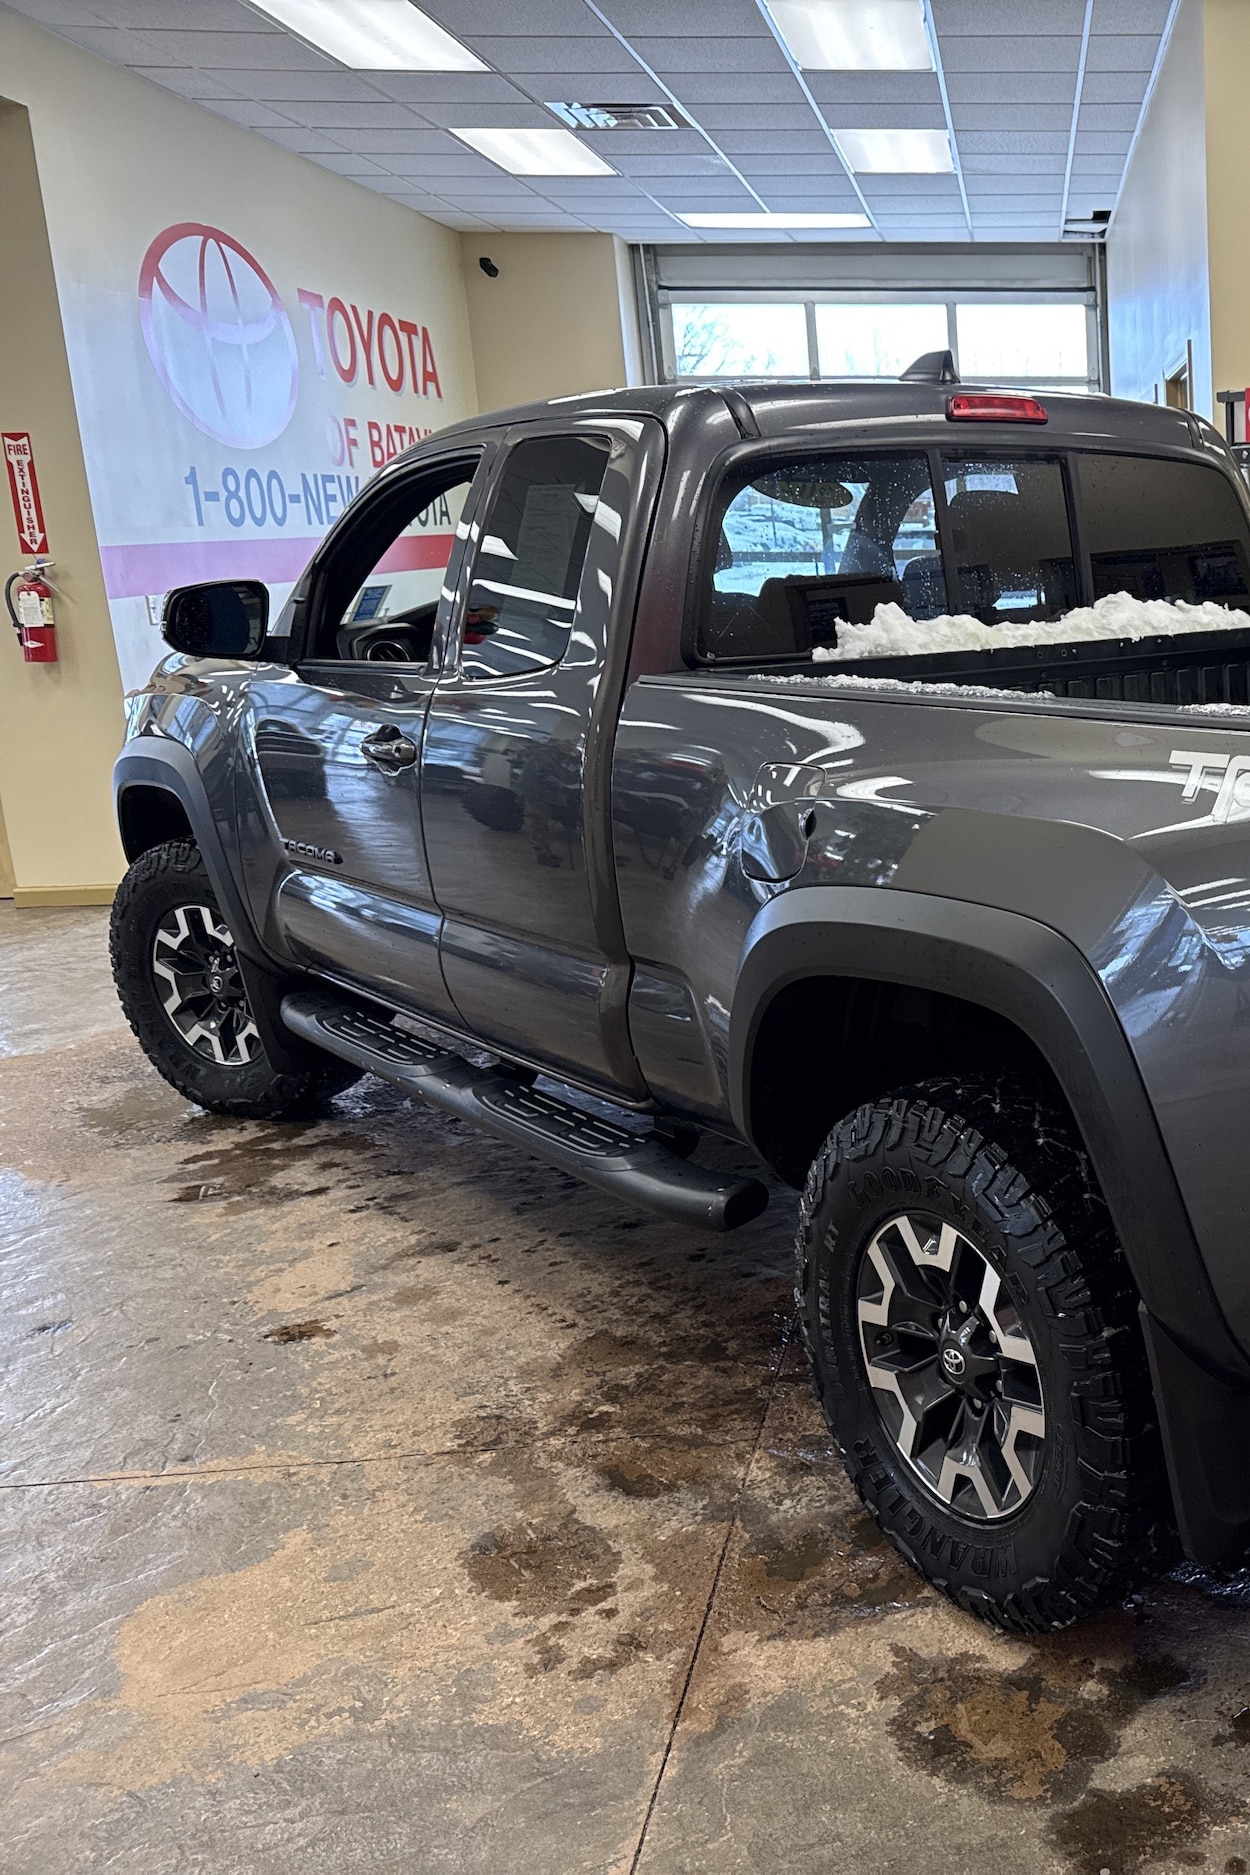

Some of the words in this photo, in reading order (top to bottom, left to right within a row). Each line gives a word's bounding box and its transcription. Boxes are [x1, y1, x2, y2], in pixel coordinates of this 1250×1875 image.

[296, 287, 443, 399] TOYOTA
[7, 443, 29, 456] FIRE
[325, 414, 358, 468] OF
[16, 459, 38, 545] EXTINGUISHER
[279, 837, 337, 864] TACOMA
[847, 1166, 1030, 1304] GOODYEAR
[853, 1435, 1018, 1578] WRANGLER
